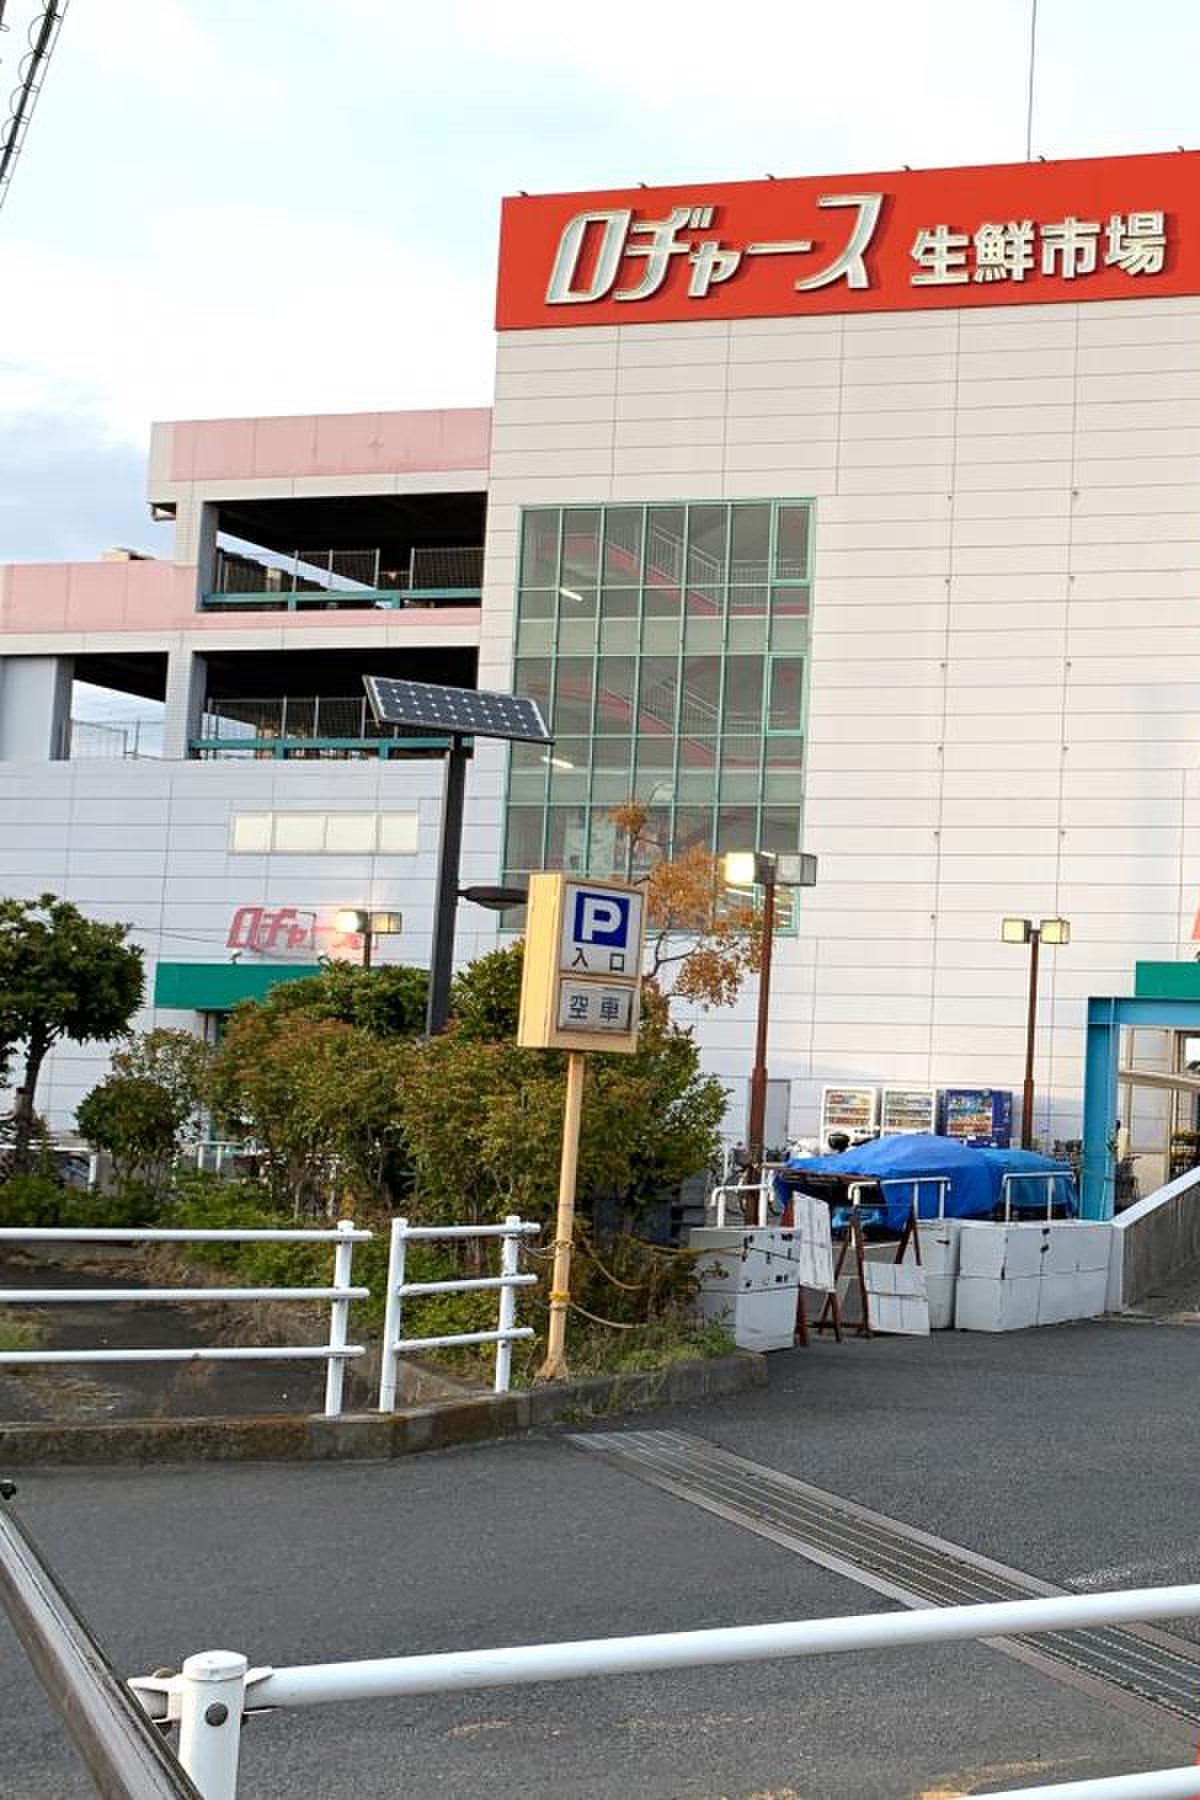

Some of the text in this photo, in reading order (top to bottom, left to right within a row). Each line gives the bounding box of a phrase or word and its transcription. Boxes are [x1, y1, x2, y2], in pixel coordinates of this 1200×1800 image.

[910, 212, 1167, 286] 生鮮市場
[581, 897, 622, 941] P
[572, 947, 625, 972] 入口
[567, 995, 621, 1022] 空車
